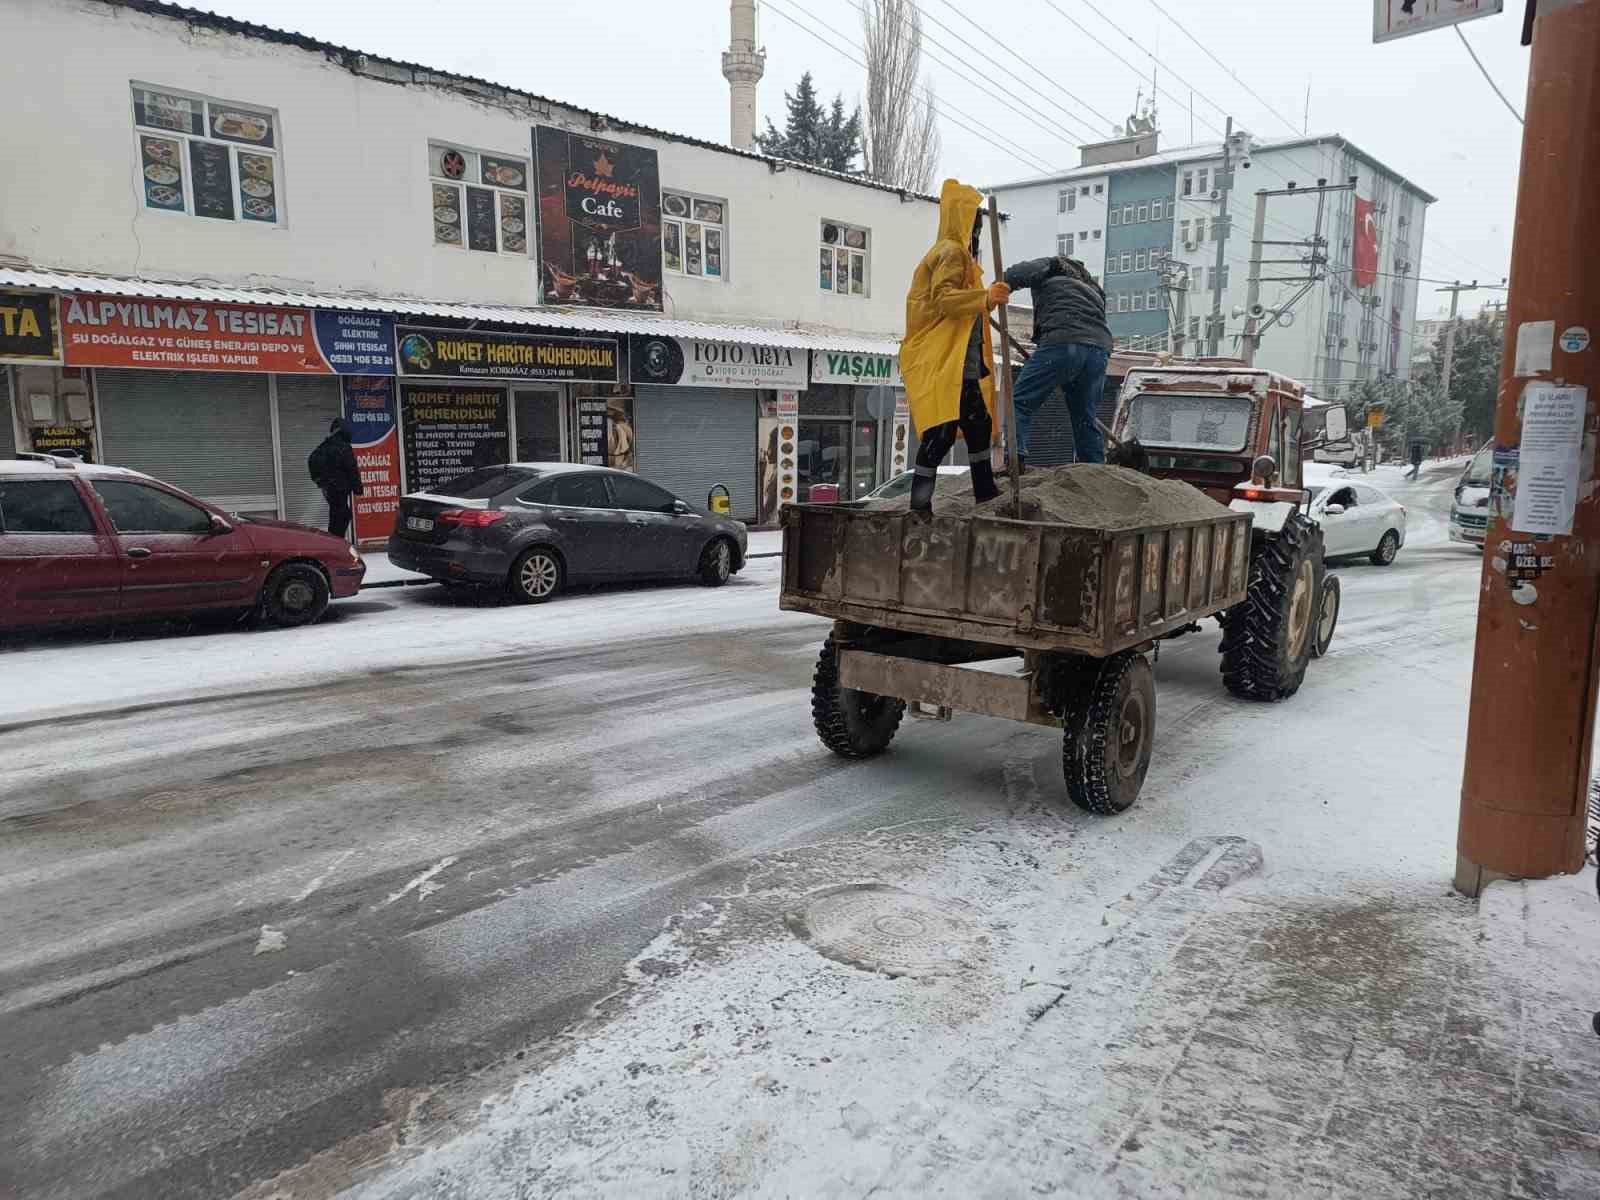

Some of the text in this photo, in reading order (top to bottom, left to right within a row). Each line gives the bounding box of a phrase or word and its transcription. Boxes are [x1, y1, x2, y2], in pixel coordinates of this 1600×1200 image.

[581, 197, 624, 218] Cafe
[67, 301, 209, 331] ALPYILMAZ
[338, 315, 382, 327] DOĞALGAZ
[72, 333, 89, 343] SU
[92, 333, 155, 347] DOĞALGAZ
[158, 338, 173, 347] VE
[176, 337, 212, 351] GÜNEŞ
[261, 343, 289, 353] DEPO
[291, 344, 305, 353] VE
[220, 354, 258, 365] YAPILIR
[330, 354, 354, 364] 0533
[487, 341, 534, 365] HARİTA
[537, 343, 613, 367] MÜHENDİSLİK
[694, 342, 793, 367] FOTO ARYA
[489, 366, 529, 376] KORKMAZ
[827, 353, 892, 382] YAŞAM
[357, 453, 391, 468] DOĞALGAZ
